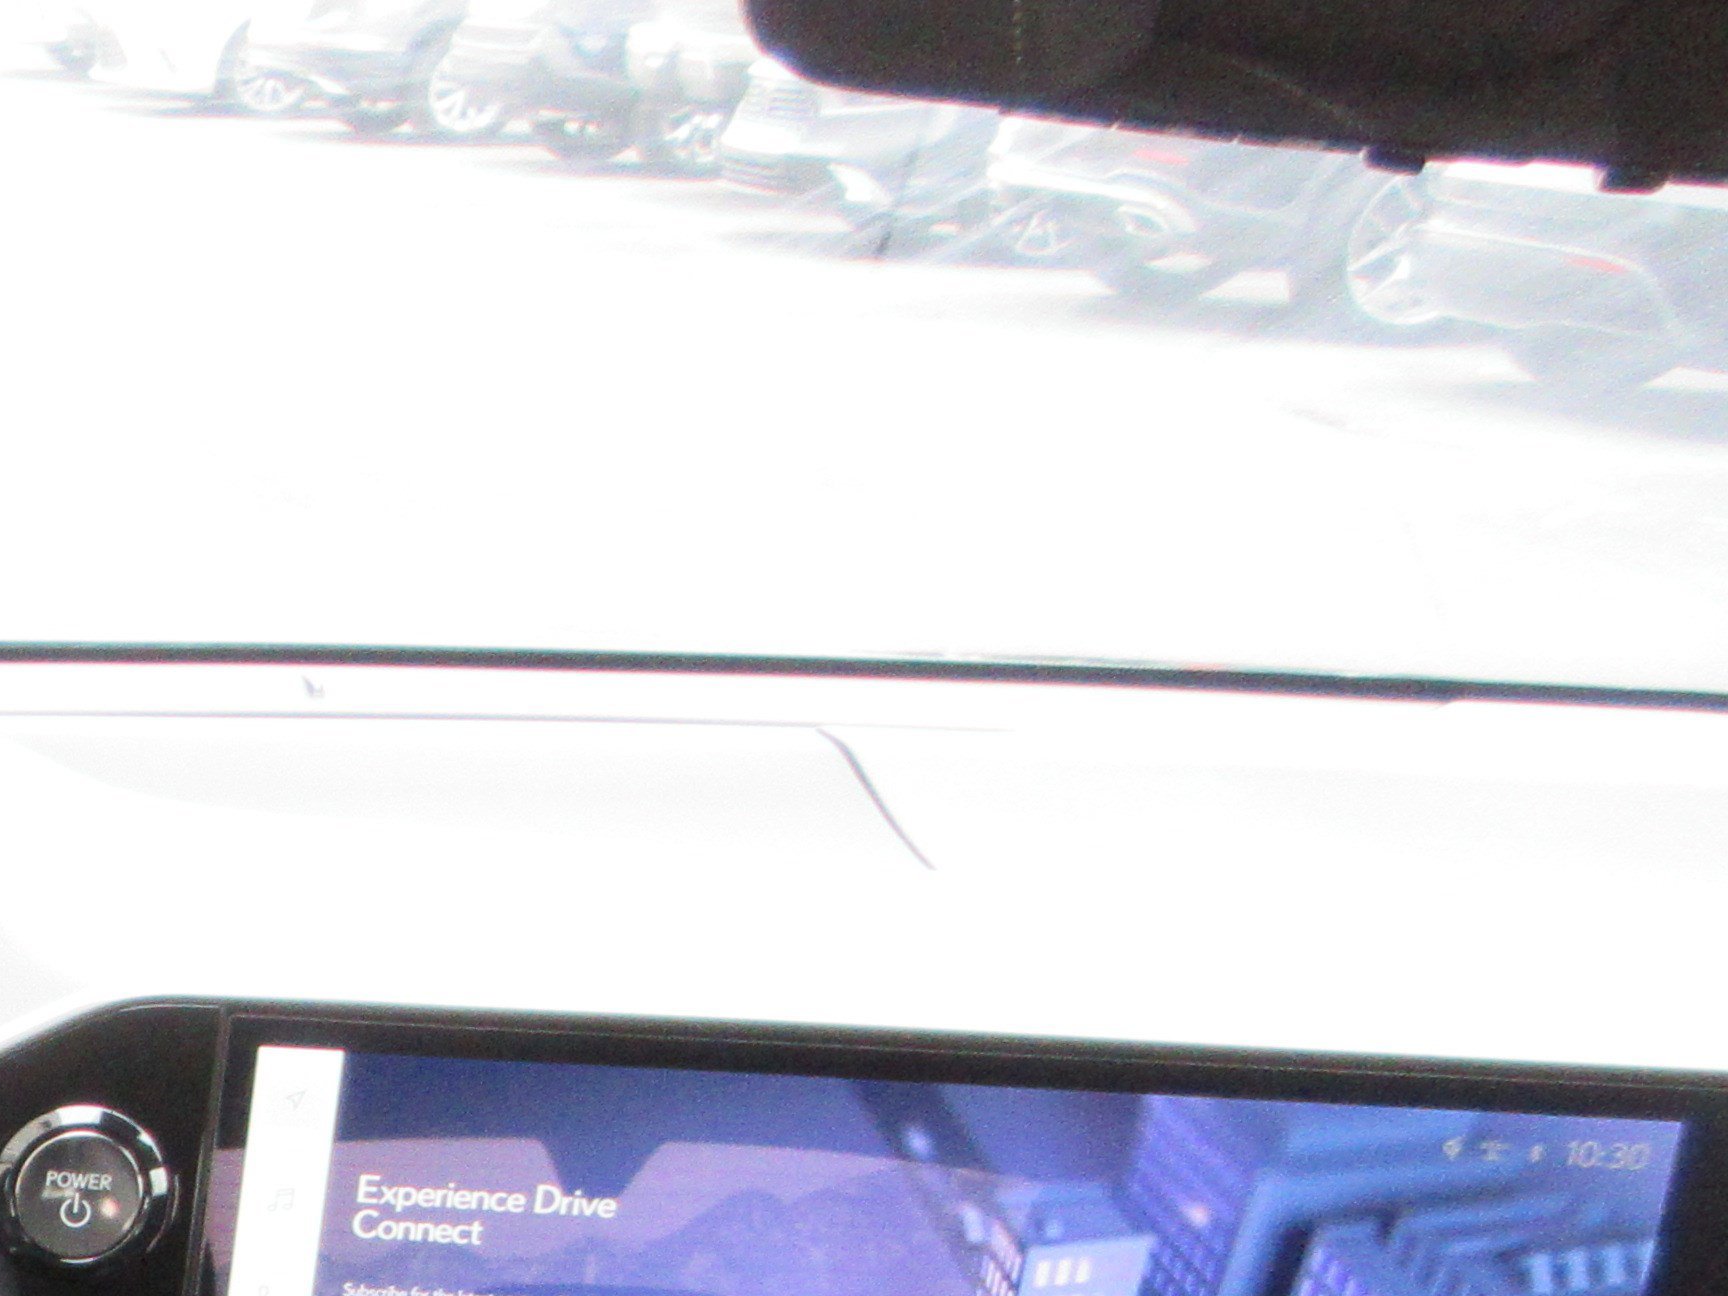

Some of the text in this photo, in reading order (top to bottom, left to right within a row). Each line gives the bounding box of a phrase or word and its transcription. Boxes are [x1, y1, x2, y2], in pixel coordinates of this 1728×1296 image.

[1565, 1140, 1653, 1172] 10:30
[45, 1169, 113, 1191] POWER
[355, 1174, 618, 1220] Experience Drive
[350, 1208, 485, 1246] Connect
